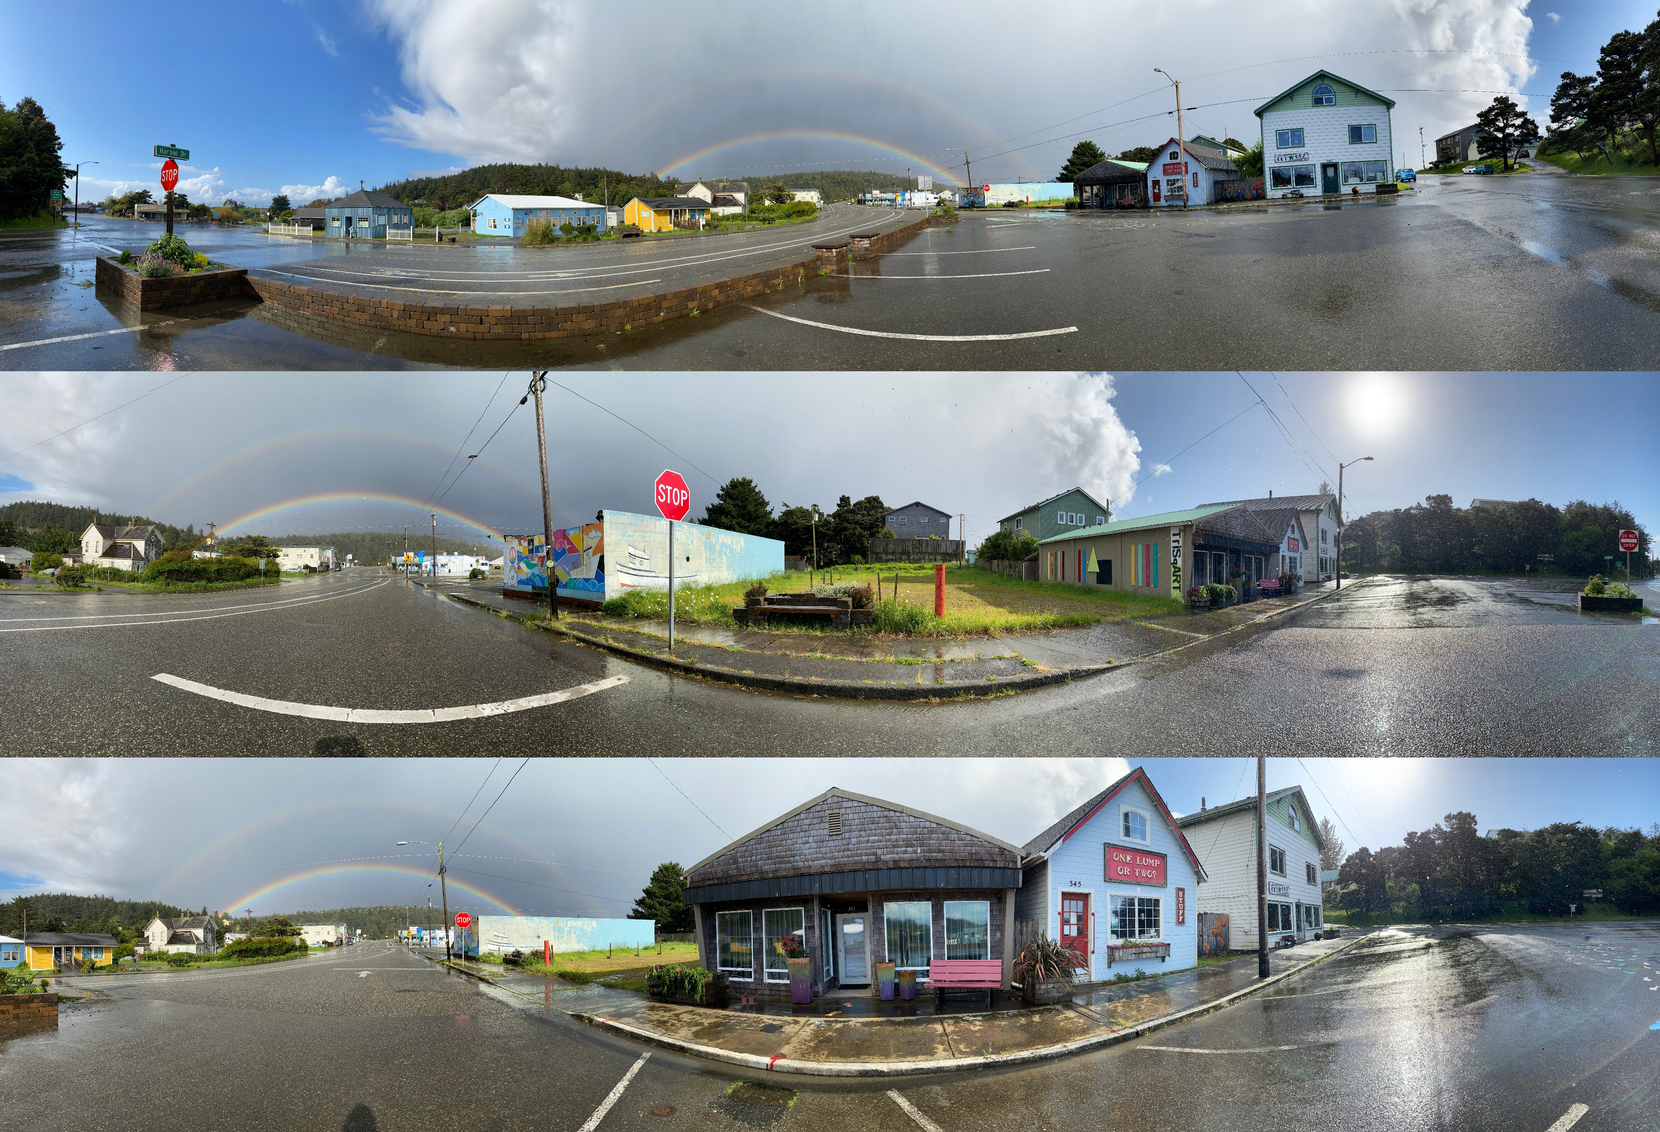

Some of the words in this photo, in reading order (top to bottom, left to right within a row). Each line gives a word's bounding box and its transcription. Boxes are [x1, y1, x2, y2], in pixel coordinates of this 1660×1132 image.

[159, 147, 178, 156] Harbor
[161, 168, 178, 182] STOP
[657, 483, 688, 507] STOP
[1112, 852, 1133, 864] ONE
[1136, 856, 1161, 868] LUMP
[1117, 866, 1130, 876] OR
[1134, 868, 1158, 879] TWO?
[1069, 880, 1082, 888] 345
[456, 916, 471, 924] STOP
